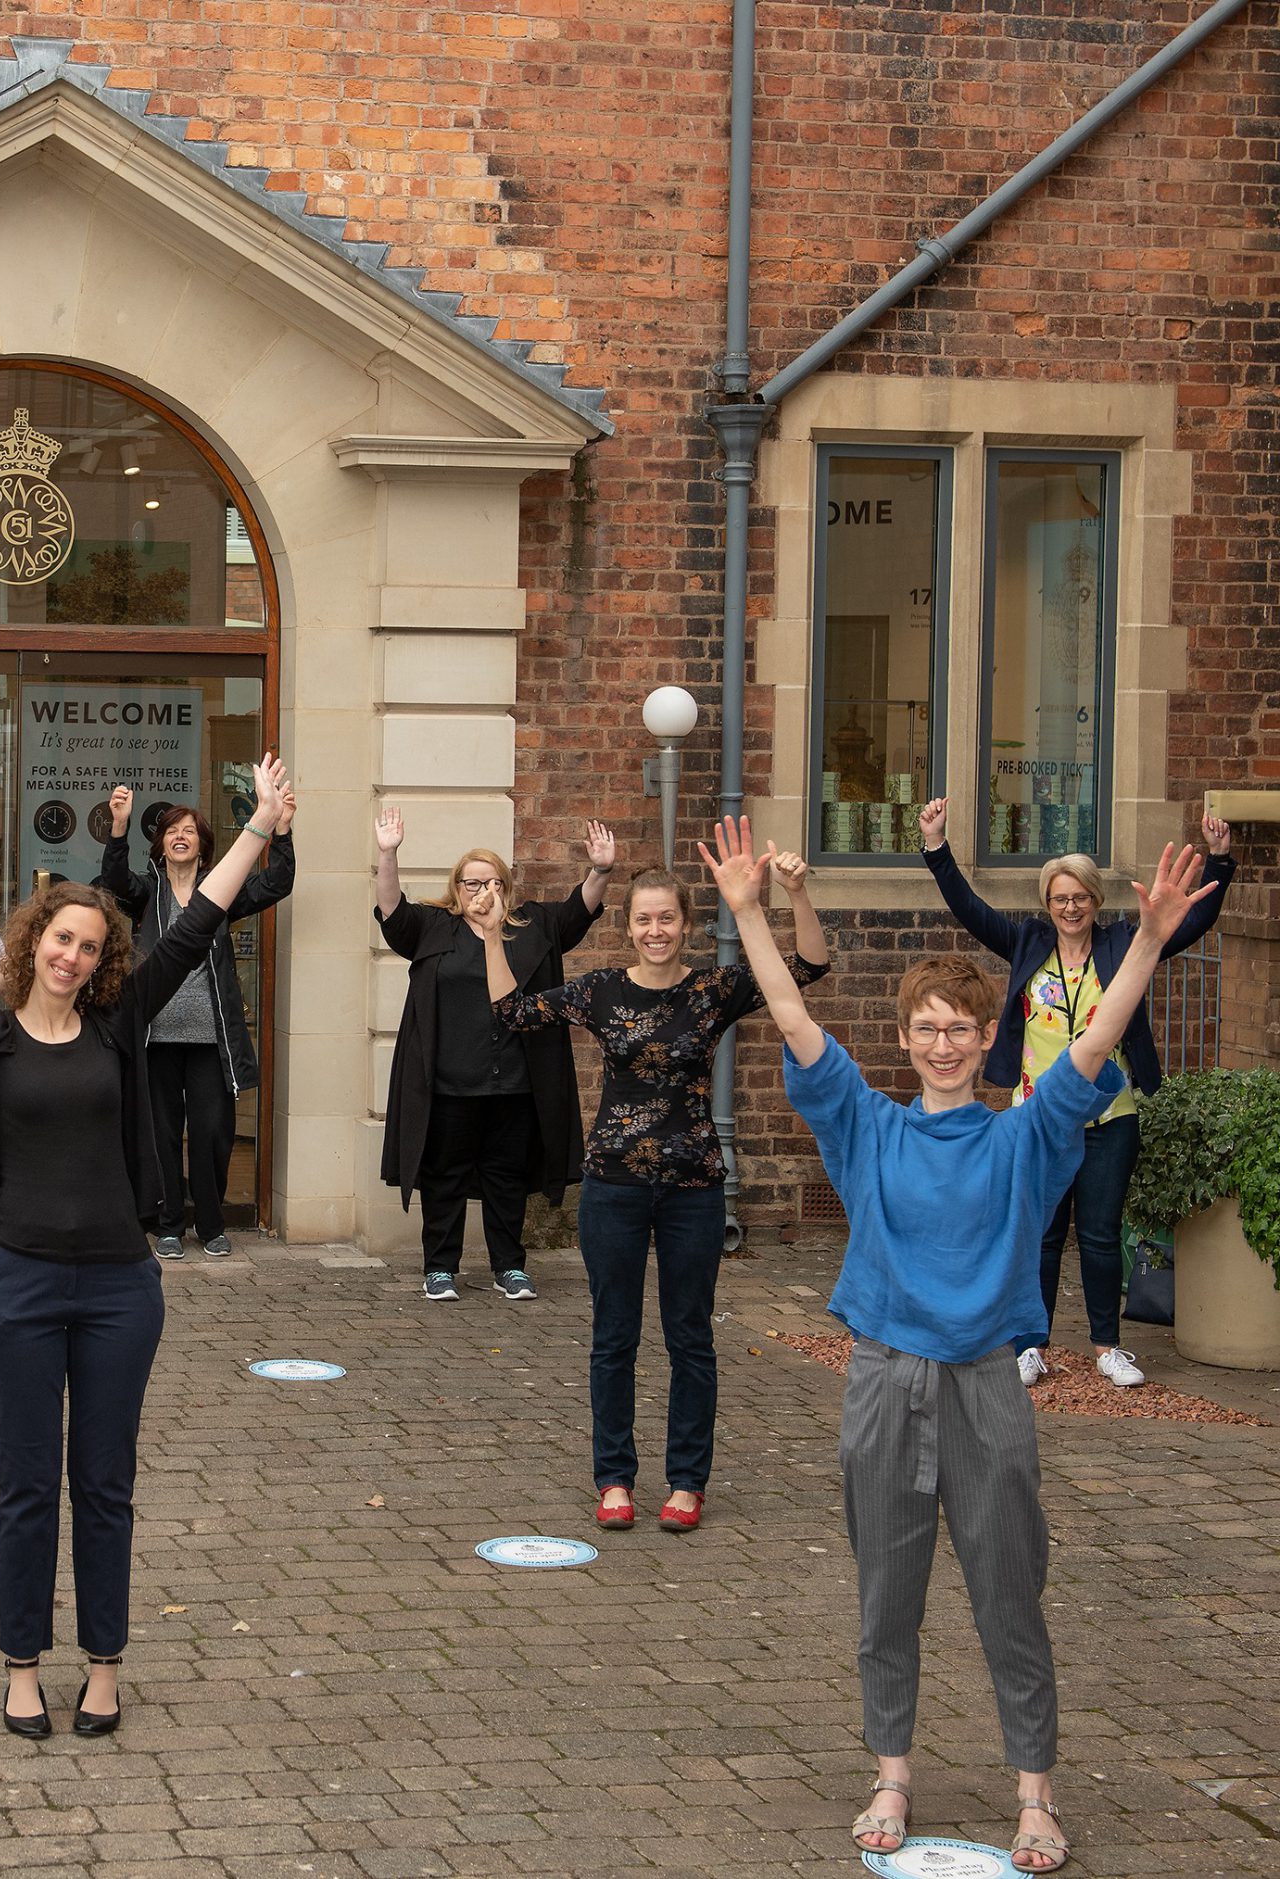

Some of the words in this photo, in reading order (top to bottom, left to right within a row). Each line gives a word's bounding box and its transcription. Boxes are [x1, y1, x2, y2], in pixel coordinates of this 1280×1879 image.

[31, 701, 192, 726] WELCOME
[40, 731, 63, 748] It’s
[66, 736, 105, 753] great
[110, 736, 124, 750] to
[128, 739, 149, 750] see
[150, 738, 180, 754] you
[31, 765, 57, 776] FOR
[61, 766, 71, 776] A
[76, 767, 108, 777] SAFE
[113, 767, 144, 778] VISIT
[148, 768, 188, 778] THESE
[997, 761, 1058, 776] PRE-BOOKED
[1061, 763, 1094, 777] TICK
[26, 780, 95, 791] MEASURES
[131, 782, 144, 792] IN
[149, 782, 193, 793] PLACE:
